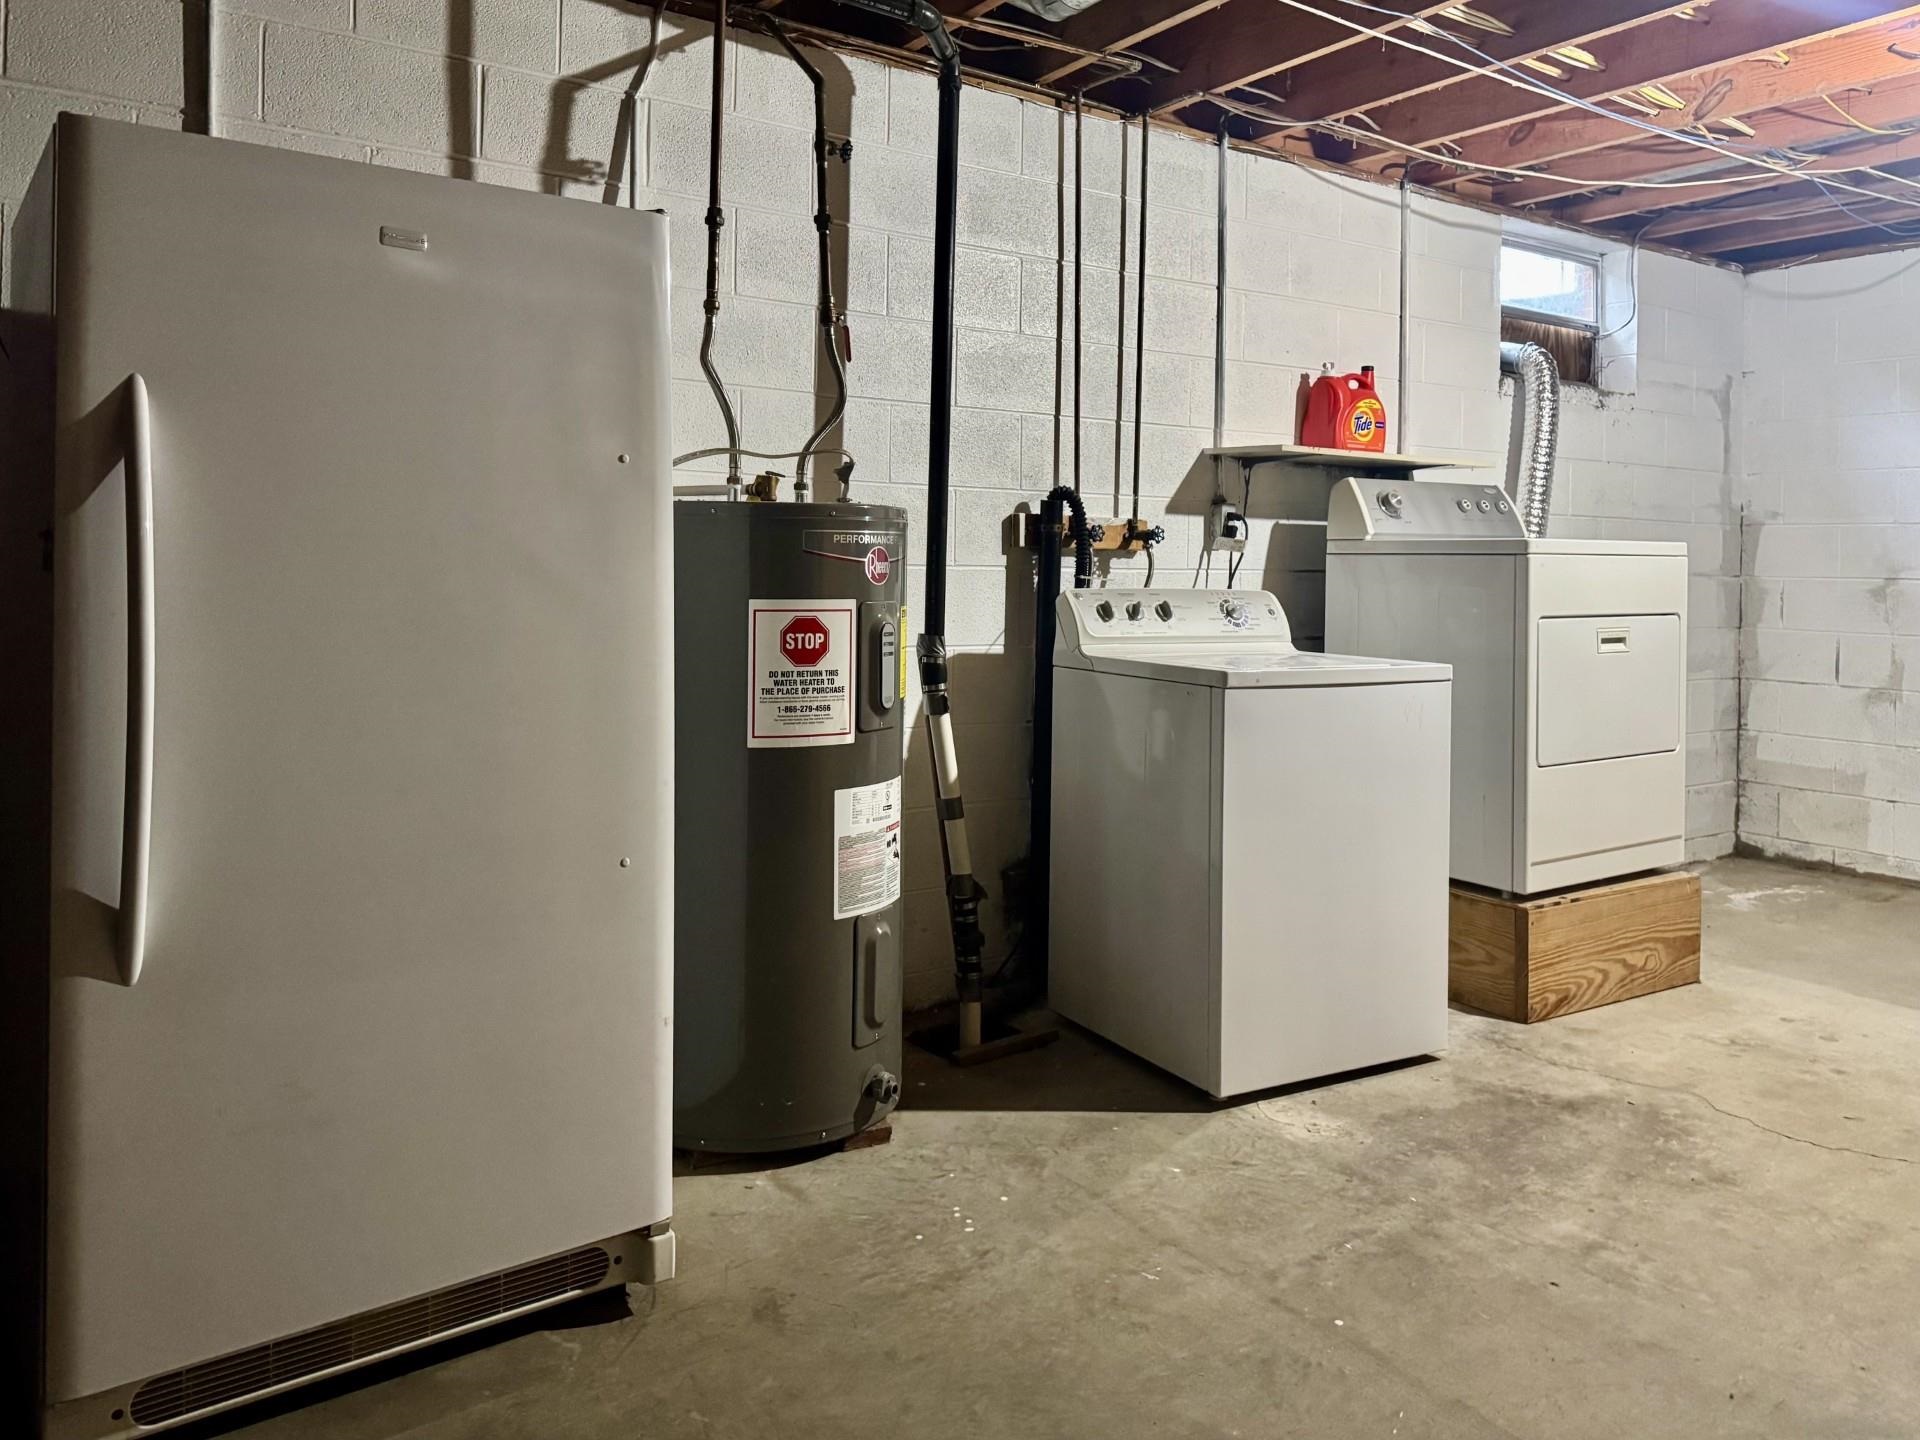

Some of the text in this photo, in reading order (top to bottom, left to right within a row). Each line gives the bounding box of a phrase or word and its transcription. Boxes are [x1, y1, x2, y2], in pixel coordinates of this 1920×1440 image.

[1354, 416, 1372, 434] Tide
[833, 534, 895, 545] PERFORMANCE
[785, 632, 825, 650] STOP
[768, 669, 839, 679] DO NOT RETURN THIS
[773, 678, 835, 687] WATER HEATER TO
[761, 686, 845, 696] THE PLACE OF PURCHASE
